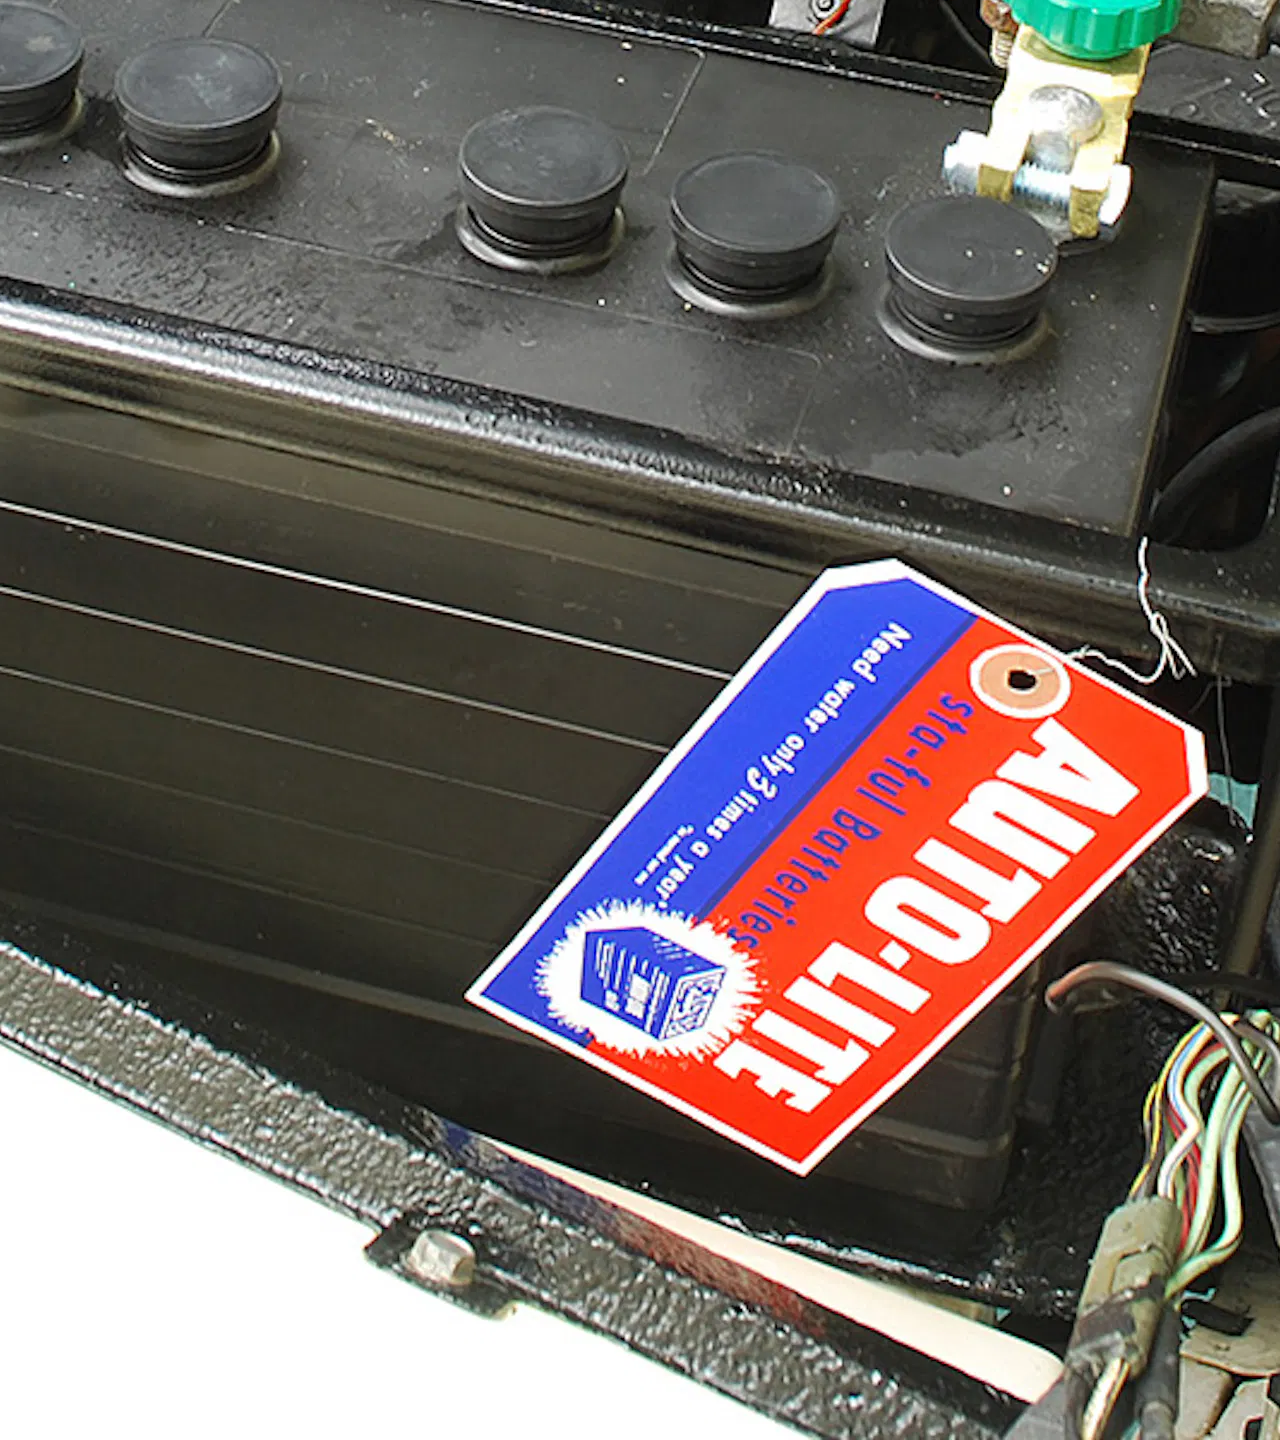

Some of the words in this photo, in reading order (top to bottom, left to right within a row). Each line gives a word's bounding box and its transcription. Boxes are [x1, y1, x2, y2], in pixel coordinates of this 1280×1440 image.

[851, 620, 914, 684] Need
[803, 676, 856, 735] water
[760, 732, 806, 775] only
[745, 766, 779, 801] 3
[705, 787, 761, 842] times
[692, 839, 711, 860] a
[727, 806, 883, 950] Batteries
[713, 715, 1141, 1115] AUTO-LITE
